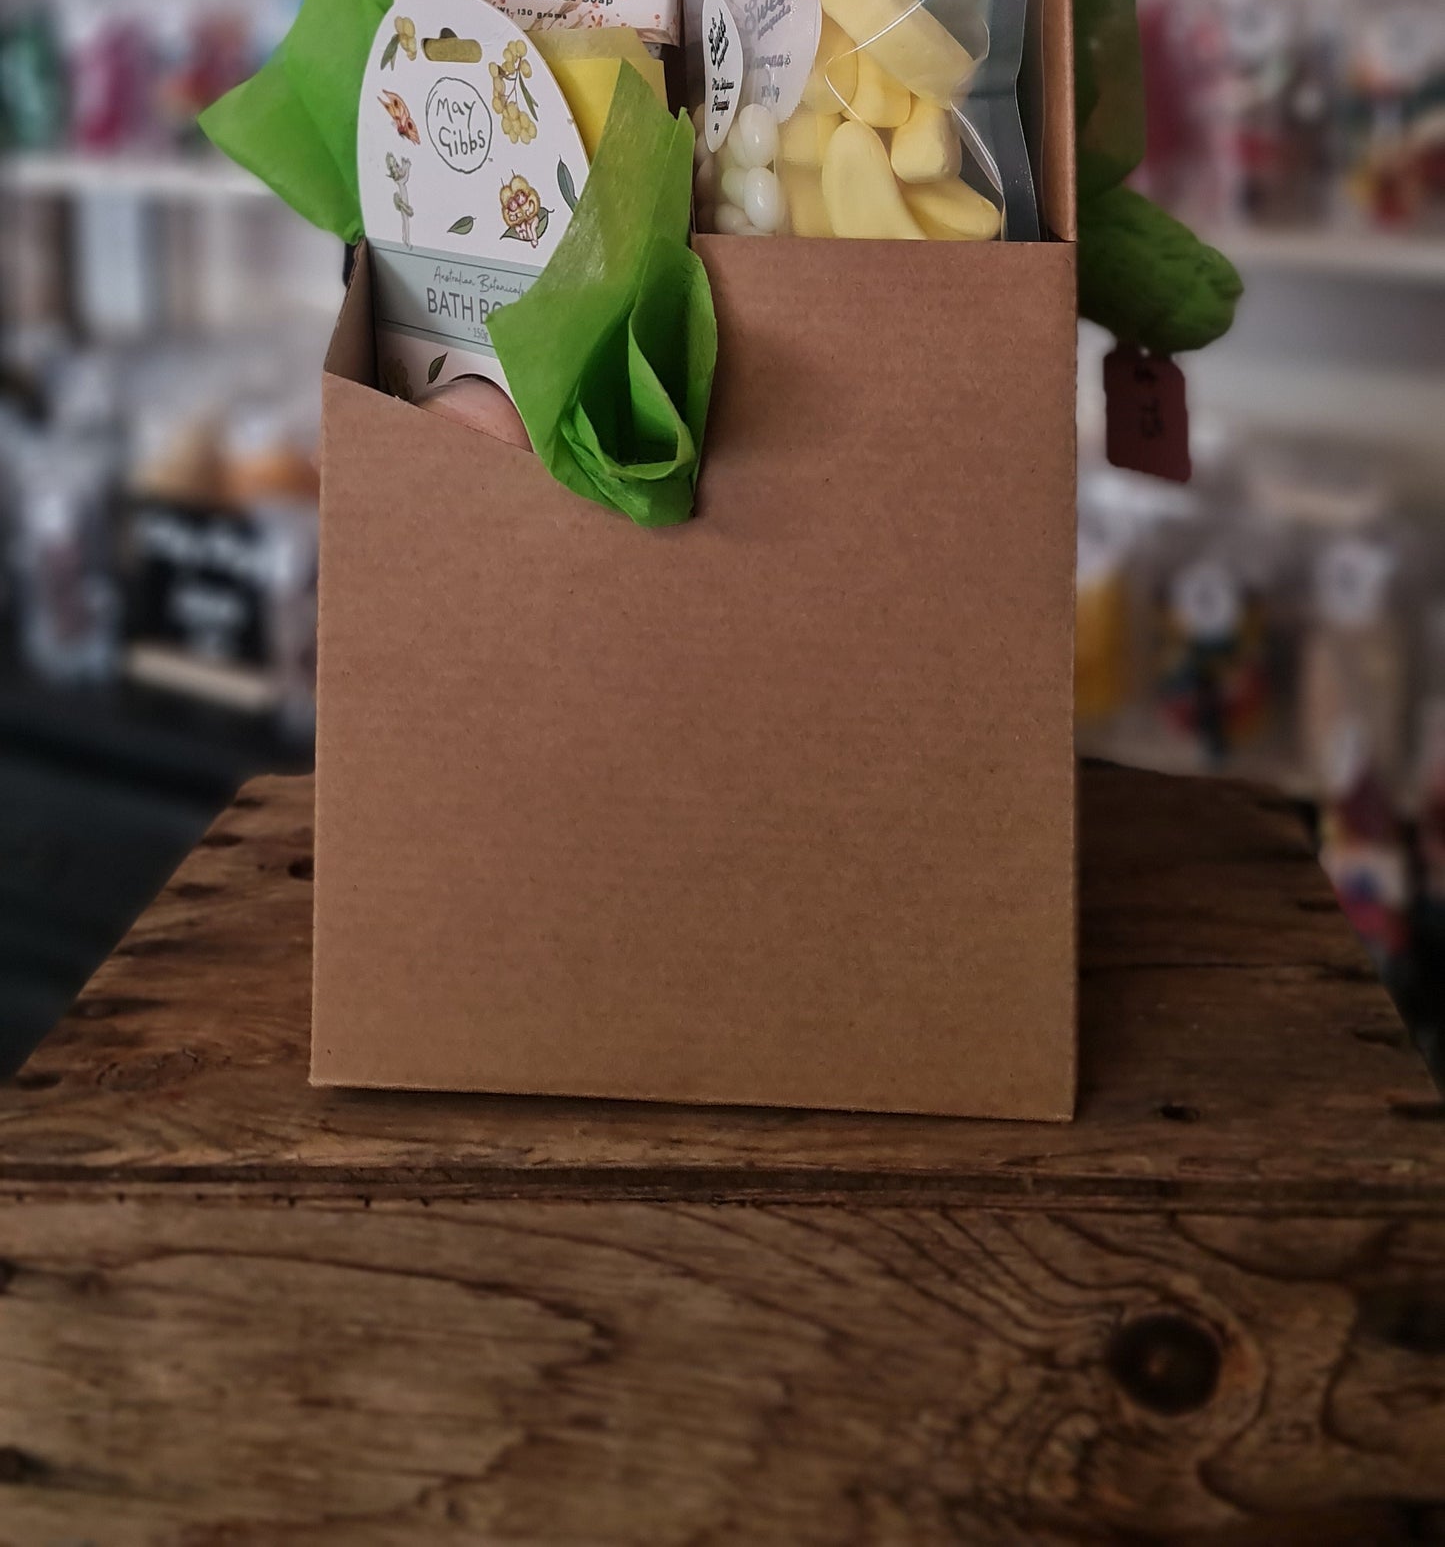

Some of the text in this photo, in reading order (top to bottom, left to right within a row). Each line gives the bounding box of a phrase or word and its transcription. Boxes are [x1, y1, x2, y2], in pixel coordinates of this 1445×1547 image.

[436, 97, 476, 131] May
[439, 126, 486, 157] Gibbs
[434, 265, 476, 286] Australian
[426, 287, 474, 323] BATH
